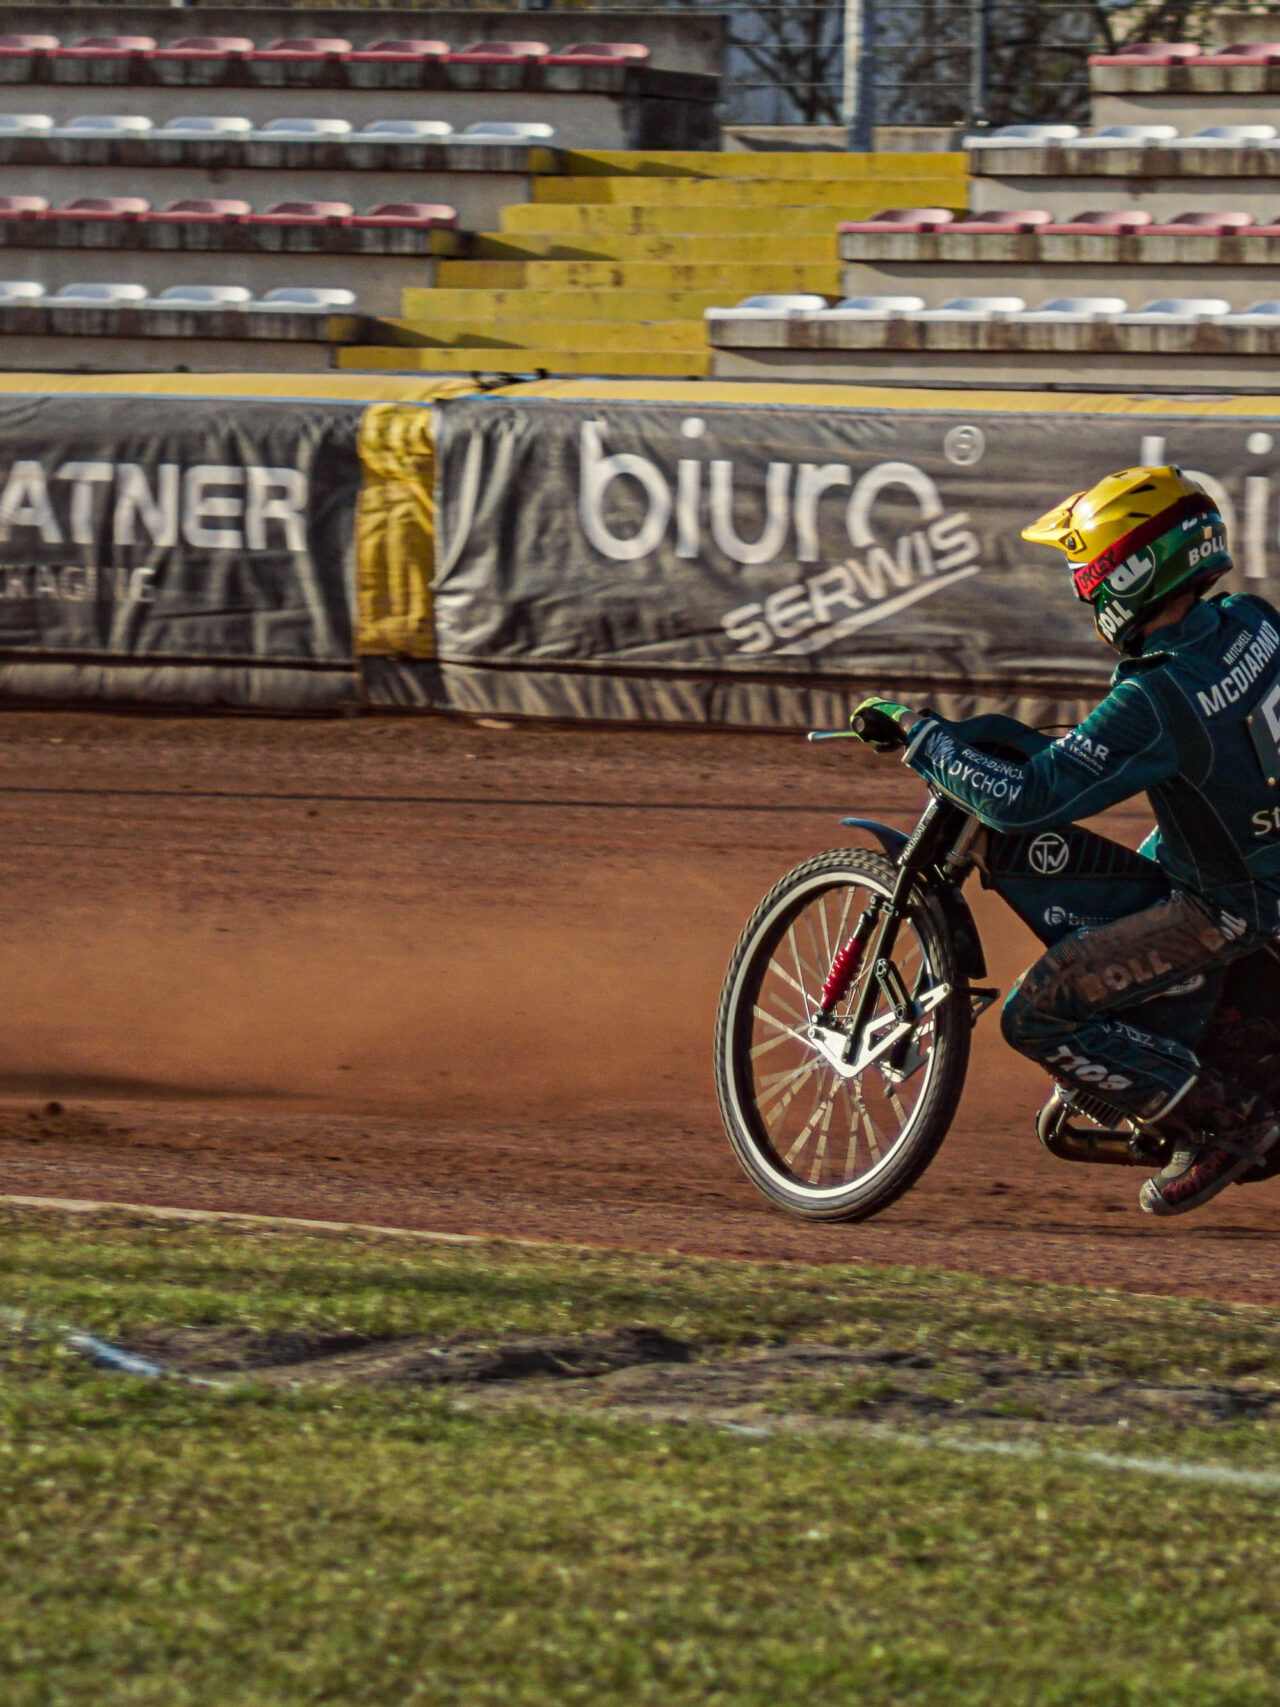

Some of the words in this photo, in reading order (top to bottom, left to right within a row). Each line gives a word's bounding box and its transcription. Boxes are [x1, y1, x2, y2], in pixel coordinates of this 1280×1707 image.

[0, 460, 309, 552] ATNER
[581, 418, 945, 564] biuro
[721, 512, 982, 655] SERWIS
[1222, 629, 1254, 666] MITCHELL
